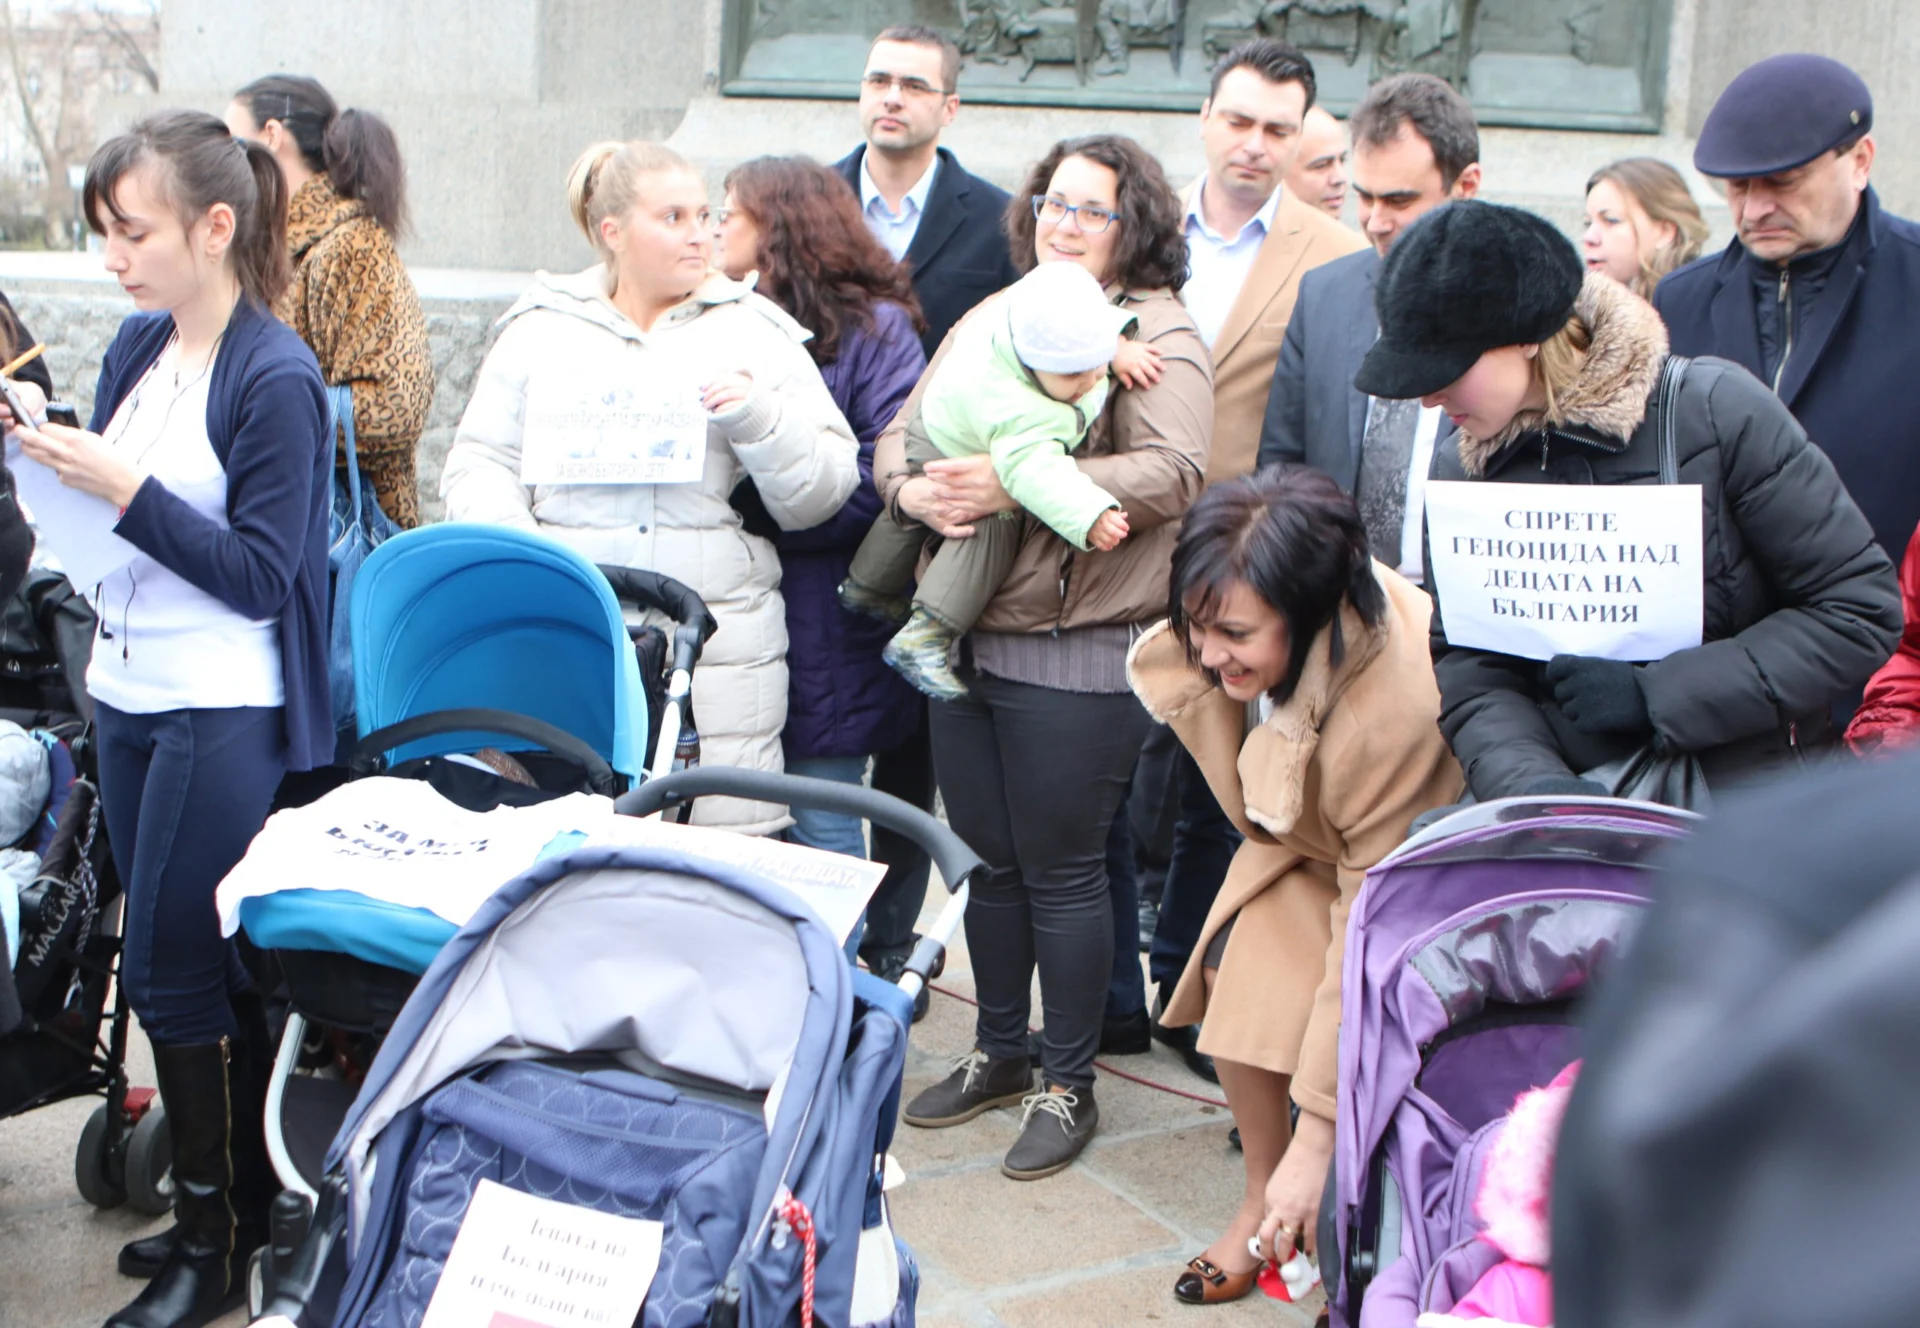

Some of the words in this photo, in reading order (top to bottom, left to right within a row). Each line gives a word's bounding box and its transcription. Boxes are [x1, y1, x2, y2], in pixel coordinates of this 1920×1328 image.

[1504, 509, 1618, 533] СПРЕТЕ
[1452, 536, 1607, 566] ГЕНОЦИДА
[1618, 543, 1680, 566] НАД
[1484, 568, 1593, 595] ДЕЦАТА
[1604, 574, 1644, 594] НА
[1491, 597, 1639, 623] БЪЛГАРИЯ
[27, 857, 86, 967] MACLARE
